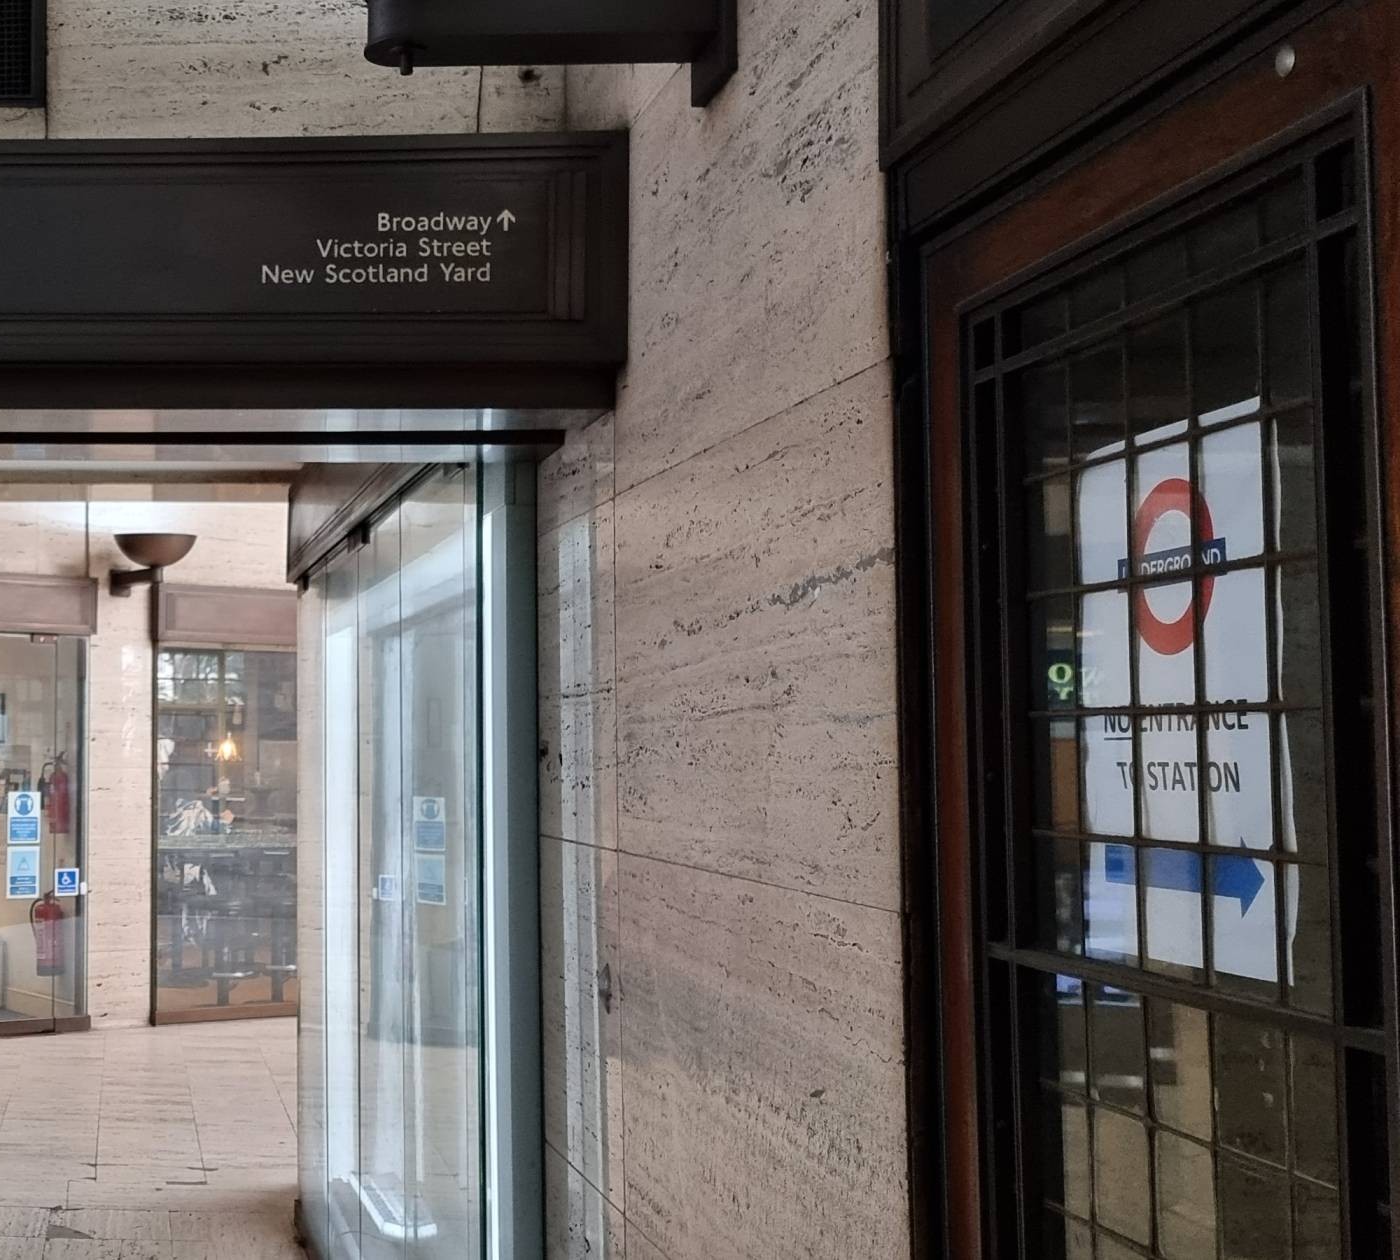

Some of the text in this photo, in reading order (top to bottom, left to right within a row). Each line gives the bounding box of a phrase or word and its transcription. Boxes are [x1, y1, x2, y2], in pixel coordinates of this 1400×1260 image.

[377, 212, 492, 235] Broadway
[317, 237, 491, 258] Victoria Street
[261, 262, 490, 283] New Scotland Yard
[1121, 548, 1221, 578] DERGROND
[1104, 705, 1132, 733] NO
[1147, 761, 1240, 792] STATON
